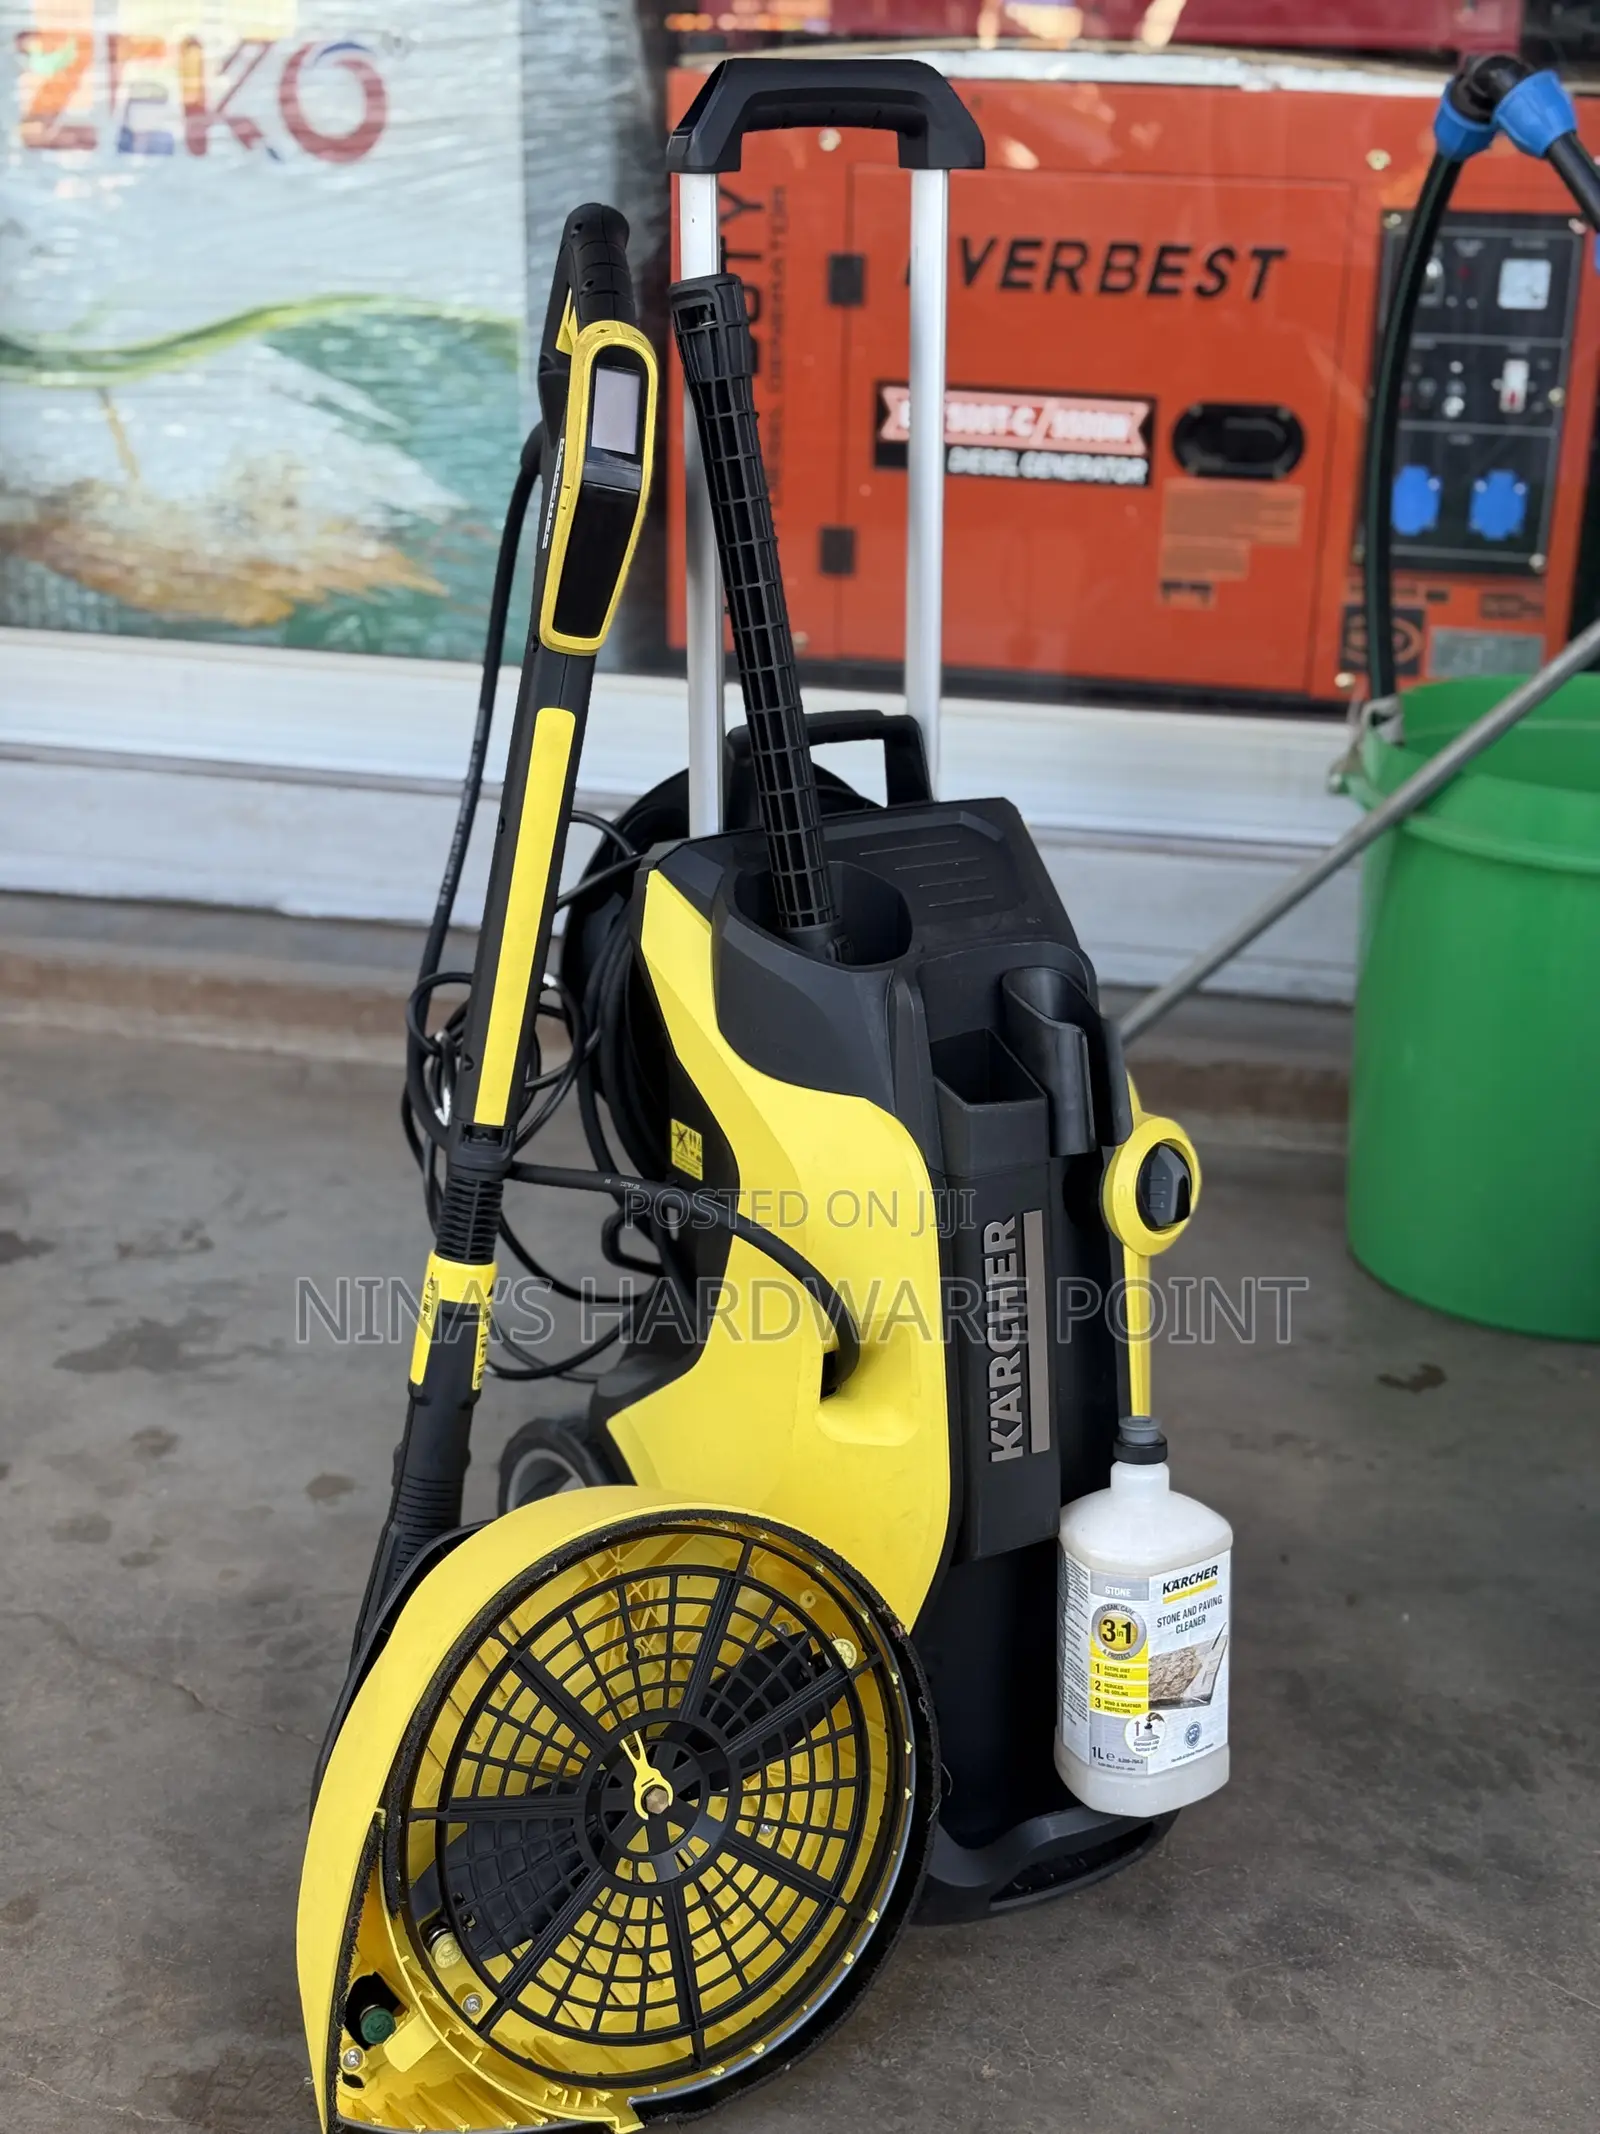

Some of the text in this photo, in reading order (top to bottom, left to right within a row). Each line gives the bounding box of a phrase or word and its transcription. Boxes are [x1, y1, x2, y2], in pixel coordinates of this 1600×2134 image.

[15, 29, 389, 164] ZEKO
[906, 235, 1287, 301] VERBEST
[983, 1216, 1024, 1462] KÄRCHER
[1162, 1565, 1219, 1595] KÄRCHER
[1104, 1585, 1132, 1598] STONE
[1156, 1594, 1223, 1629] STONE AND PAVING
[1175, 1614, 1207, 1635] CLEANER
[1095, 1663, 1100, 1674] 1
[1094, 1680, 1101, 1692] 2
[1095, 1697, 1101, 1709] 3
[1091, 1746, 1104, 1760] 1L
